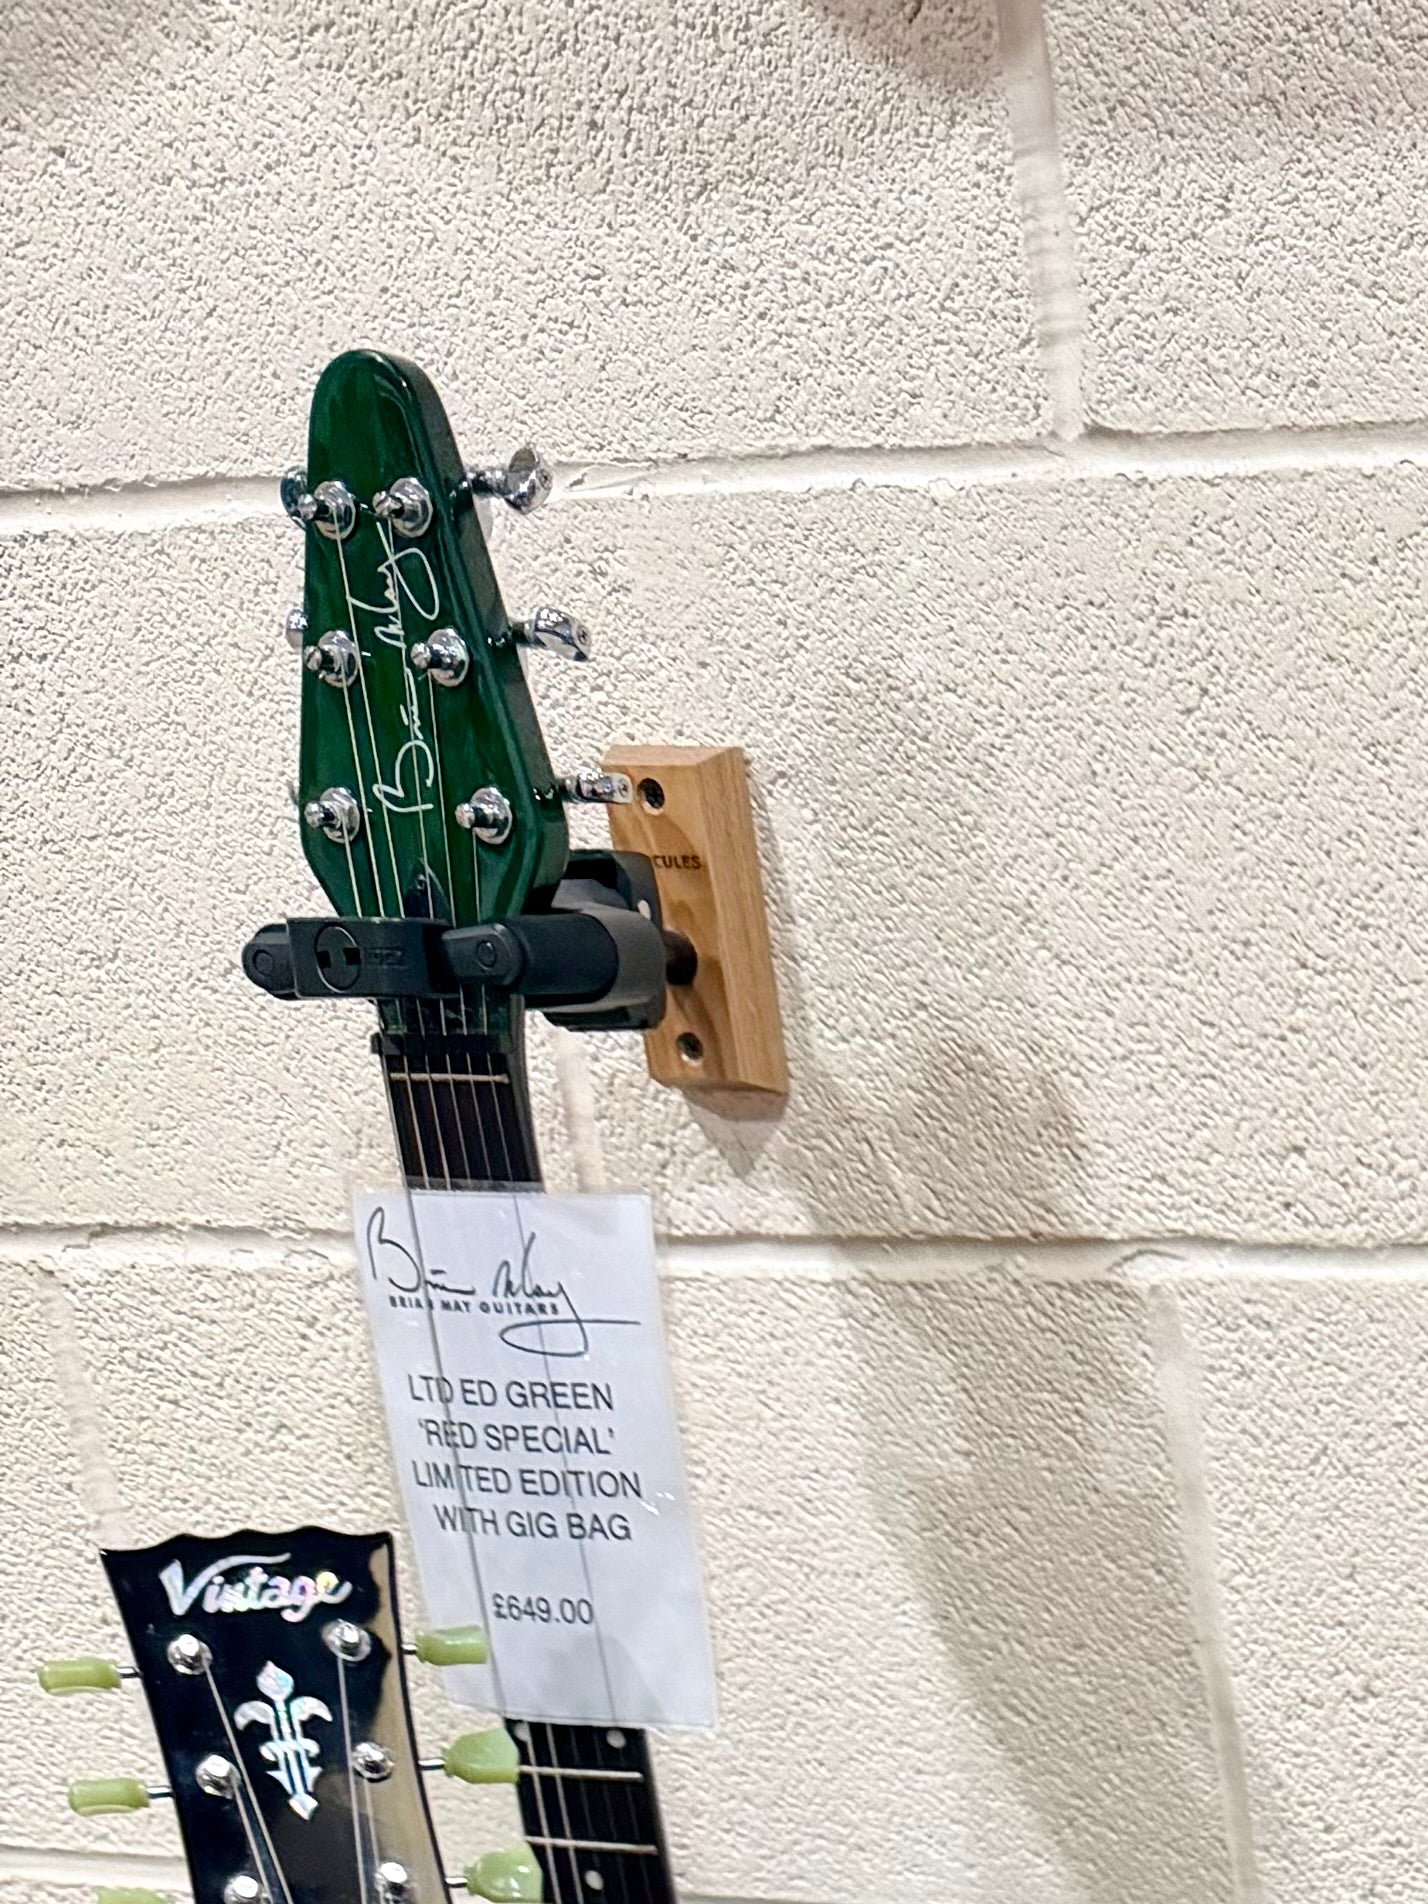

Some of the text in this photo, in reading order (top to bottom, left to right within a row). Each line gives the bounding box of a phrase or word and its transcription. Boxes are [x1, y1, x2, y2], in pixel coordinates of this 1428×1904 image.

[440, 1298, 471, 1313] MAY
[408, 1373, 614, 1411] LTD ED GREEN
[411, 1459, 643, 1499] LIMTED EDITION
[433, 1503, 633, 1541] WITH GIG BAG
[158, 1552, 352, 1623] Vintage
[491, 1592, 594, 1625] £649.00
